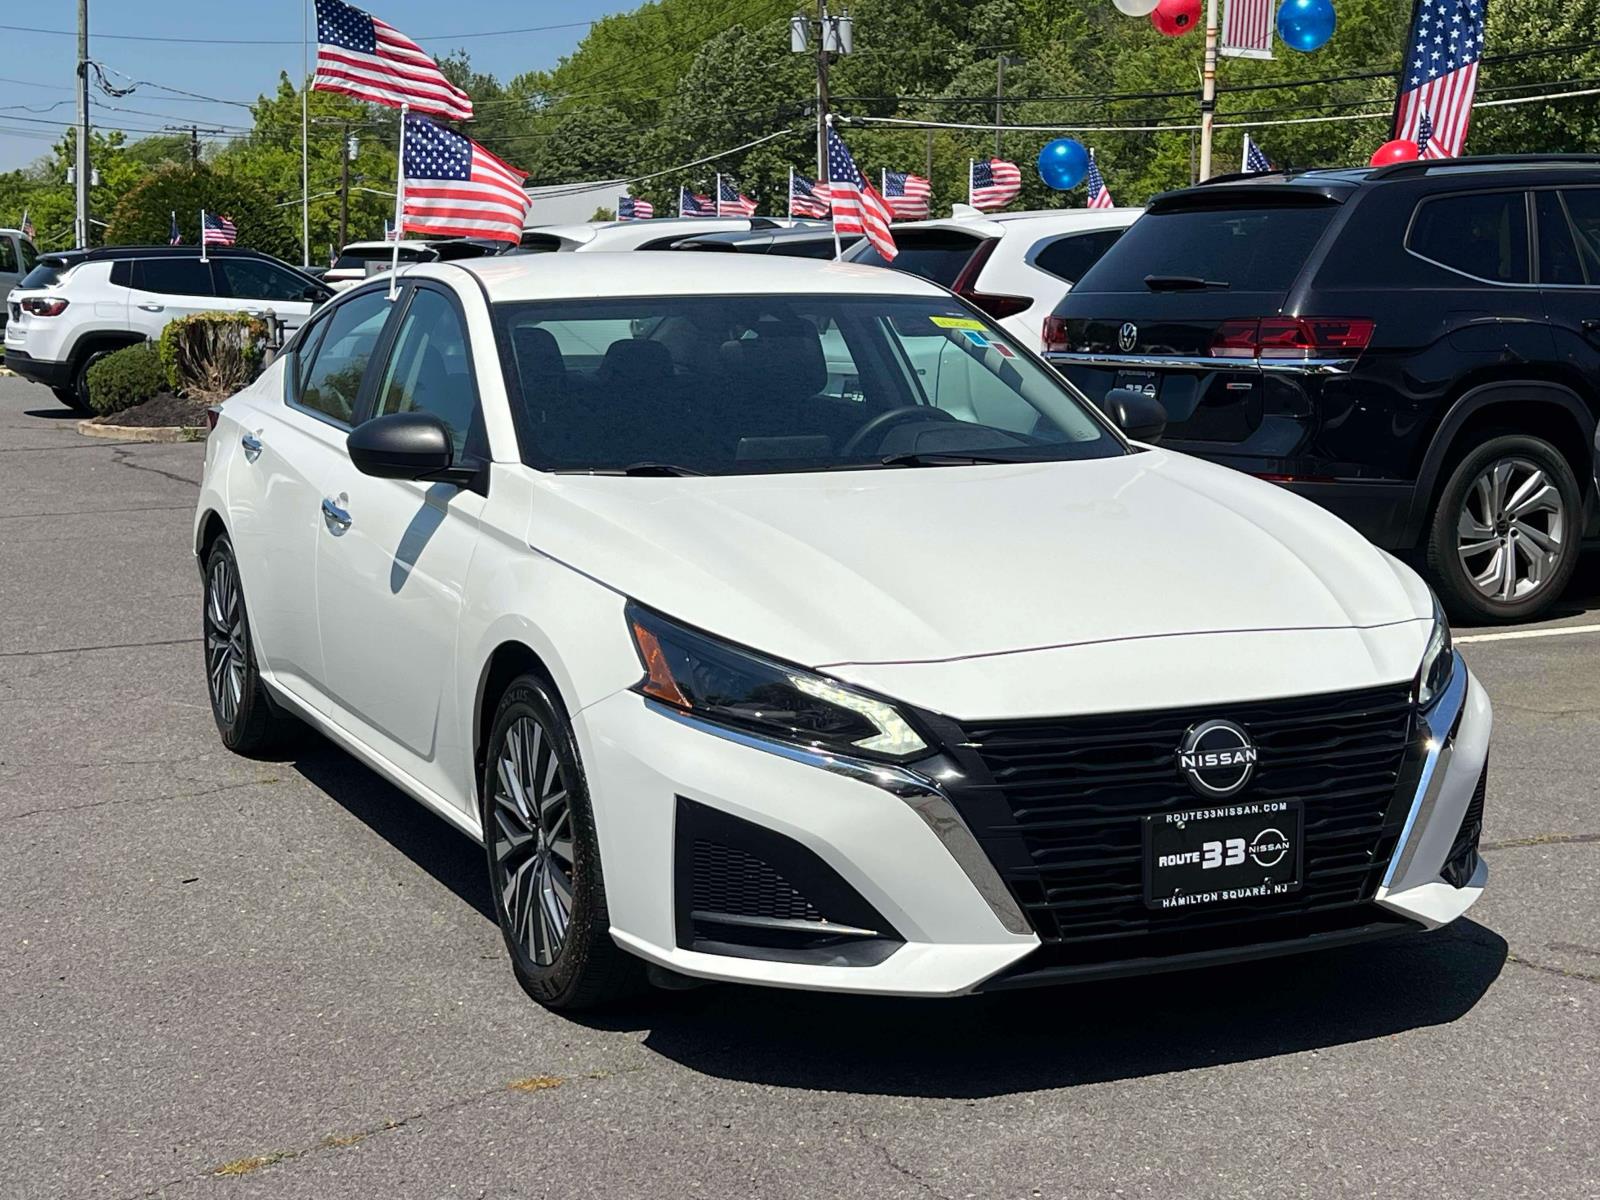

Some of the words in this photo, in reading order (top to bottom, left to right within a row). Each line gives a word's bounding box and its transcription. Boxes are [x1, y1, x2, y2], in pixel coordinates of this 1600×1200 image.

[1181, 748, 1257, 768] NISSAN
[1166, 802, 1287, 823] ROUTE33NISSAN.COM
[1158, 851, 1200, 867] ROUTE
[1202, 837, 1246, 870] 33
[1248, 841, 1290, 854] NISSAN
[1162, 891, 1218, 908] HAMILTON
[1274, 884, 1288, 894] NJ
